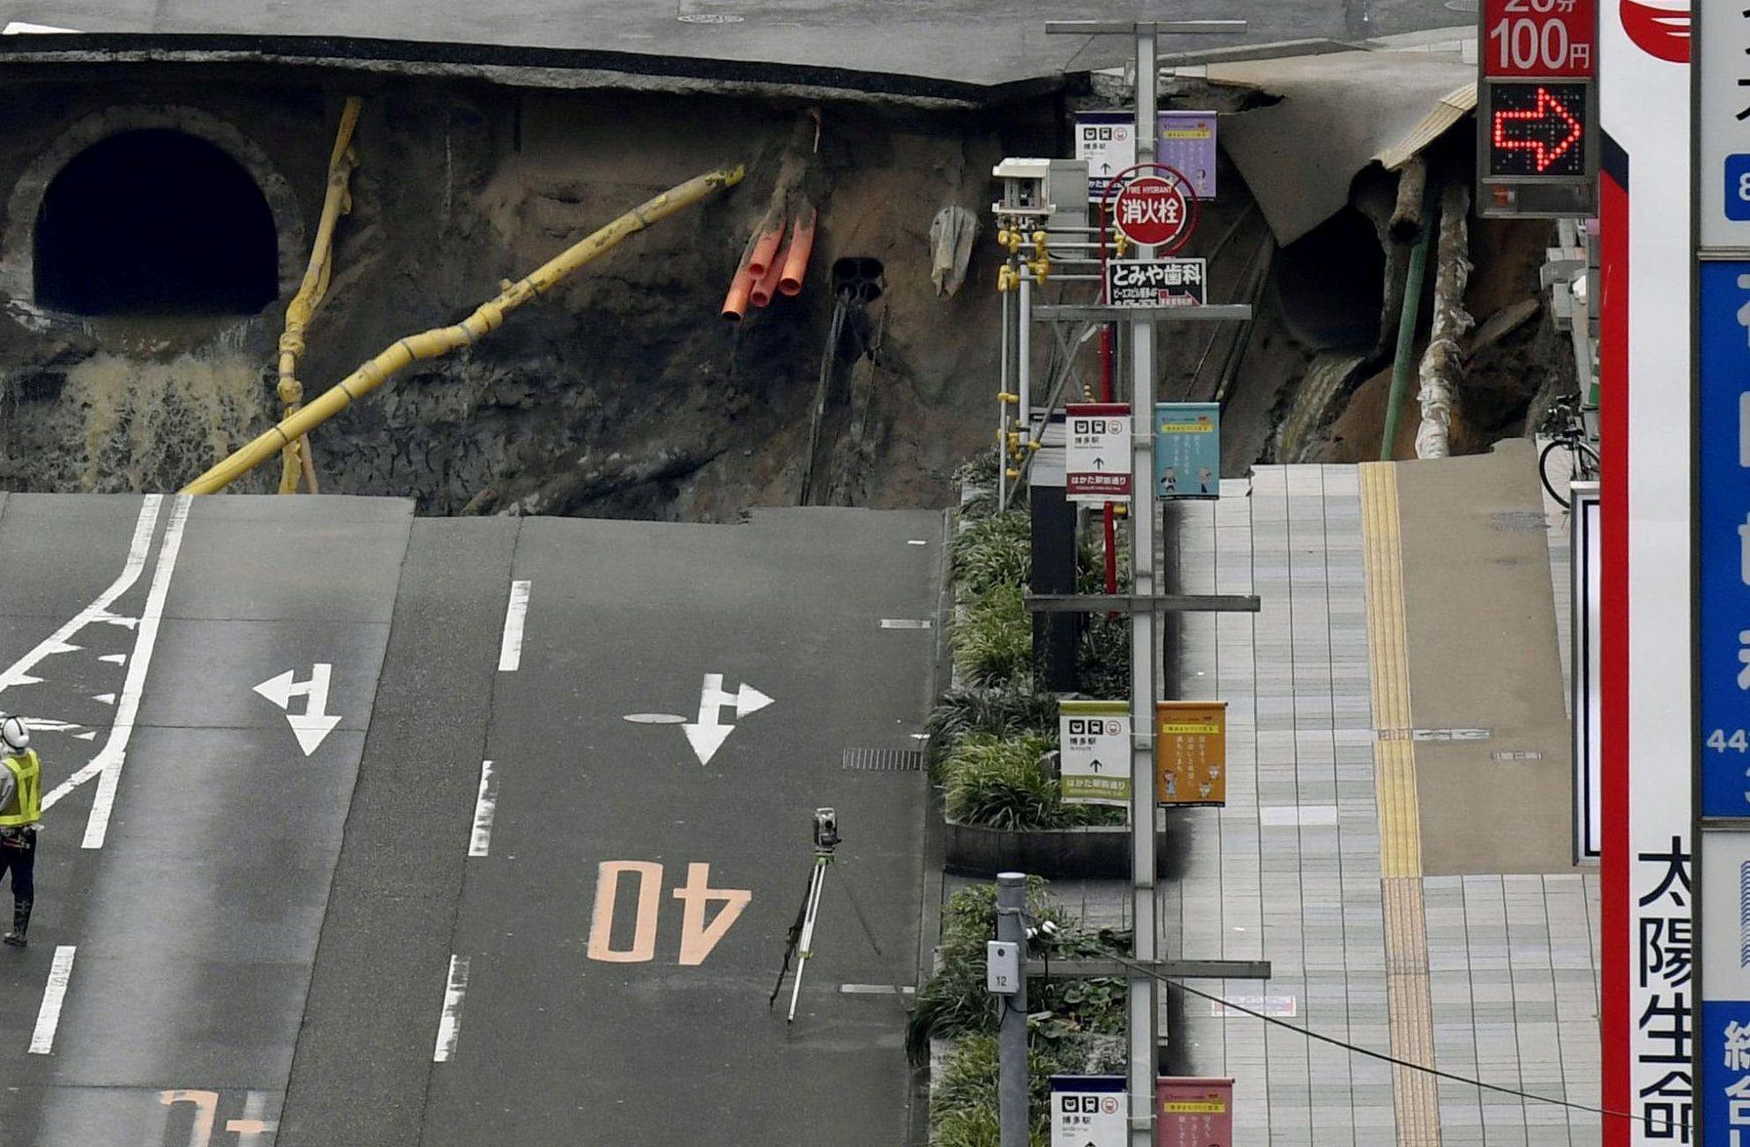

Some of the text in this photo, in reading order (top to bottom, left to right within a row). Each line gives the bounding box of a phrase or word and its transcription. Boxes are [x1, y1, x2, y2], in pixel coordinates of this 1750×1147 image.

[1490, 18, 1590, 69] 100円
[1122, 198, 1179, 224] 消火栓
[1113, 264, 1201, 286] とみや歯科
[587, 860, 753, 965] 40
[996, 975, 1008, 987] 12
[1638, 835, 1692, 1145] 太陽生命
